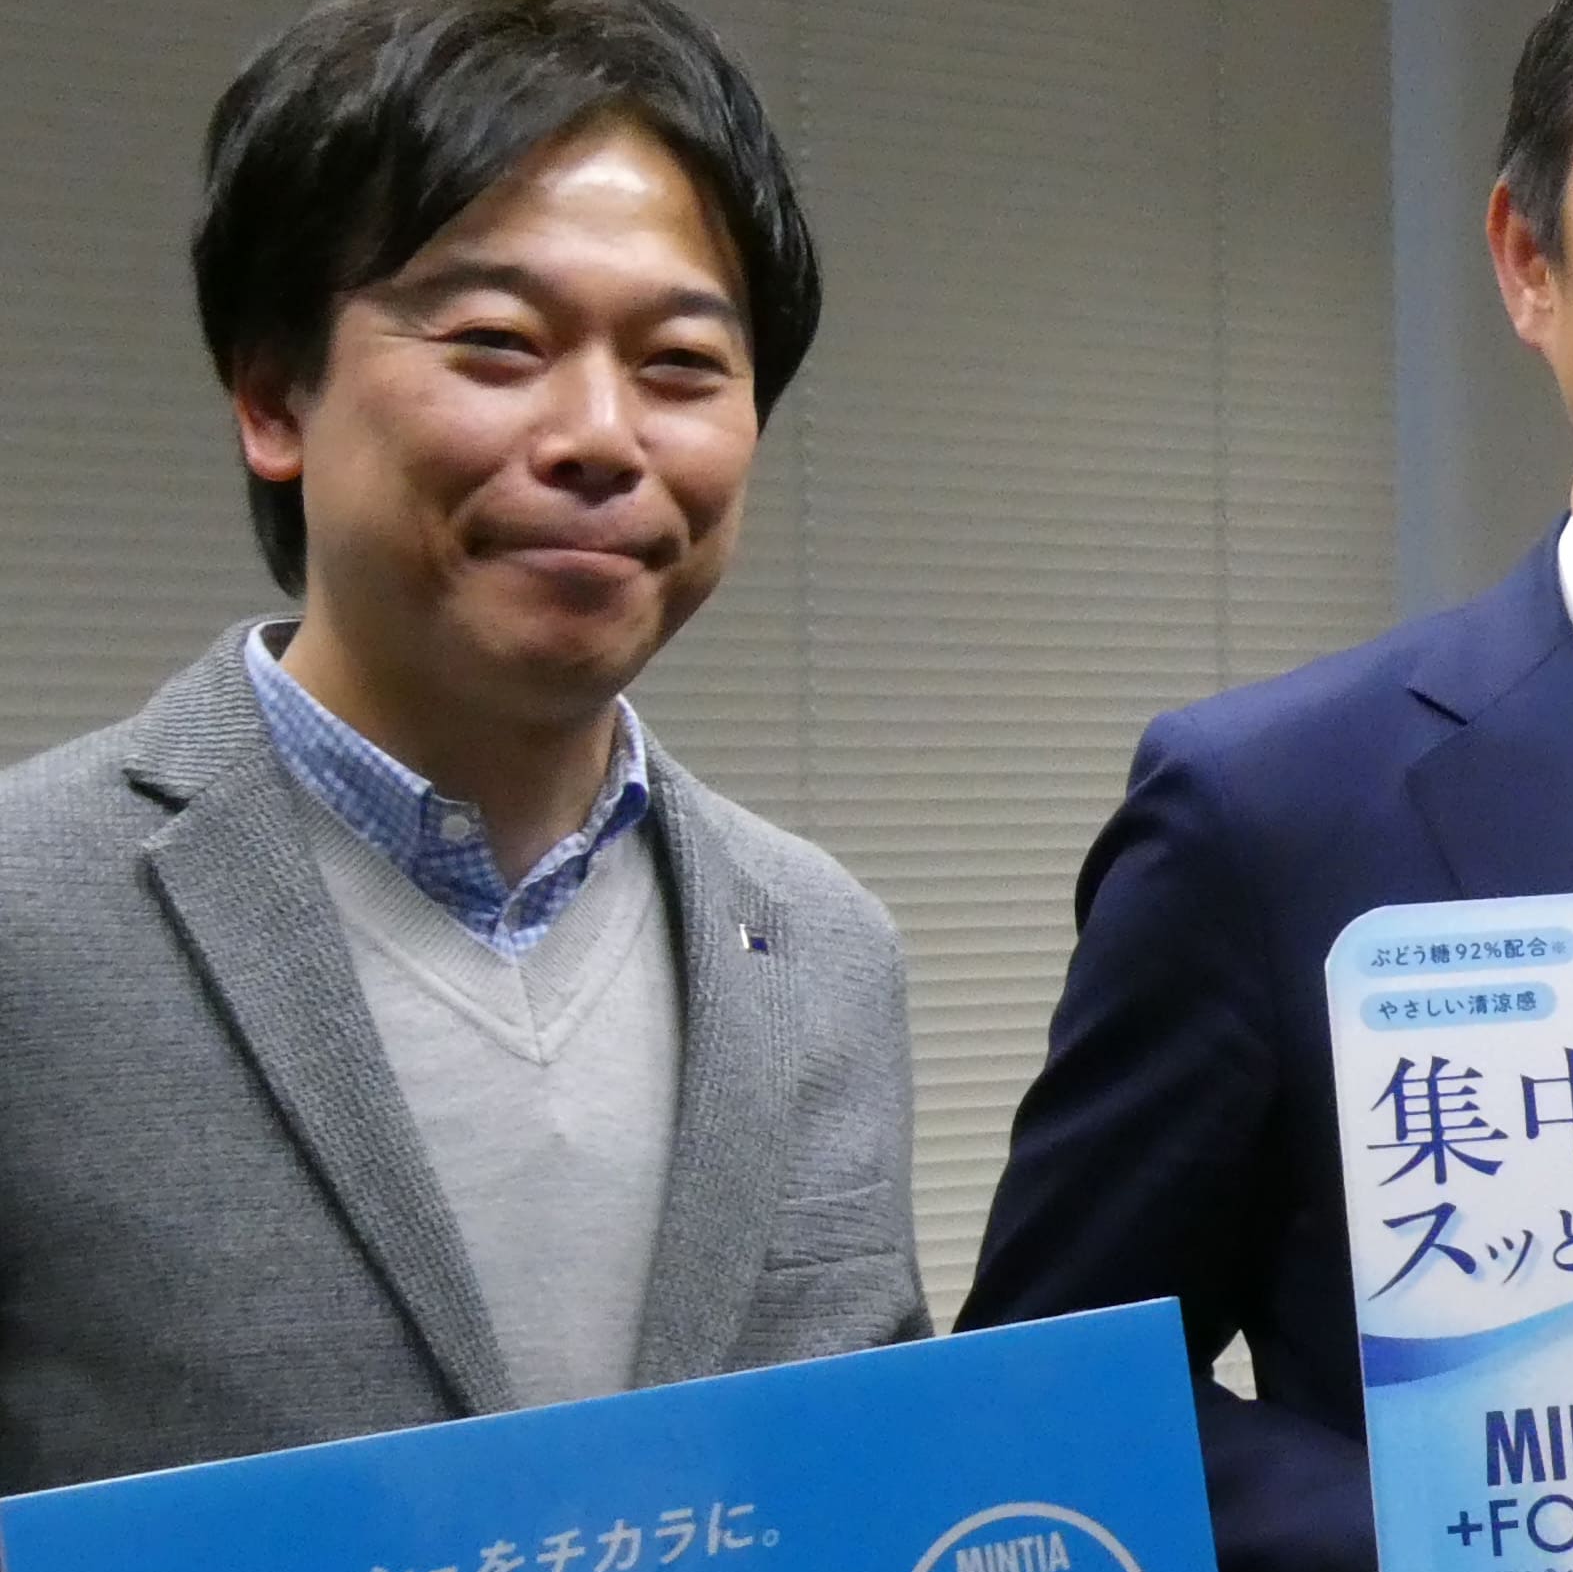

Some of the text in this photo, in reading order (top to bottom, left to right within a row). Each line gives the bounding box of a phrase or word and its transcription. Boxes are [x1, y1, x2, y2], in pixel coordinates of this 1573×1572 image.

[1378, 990, 1537, 1020] やさしい清涼感
